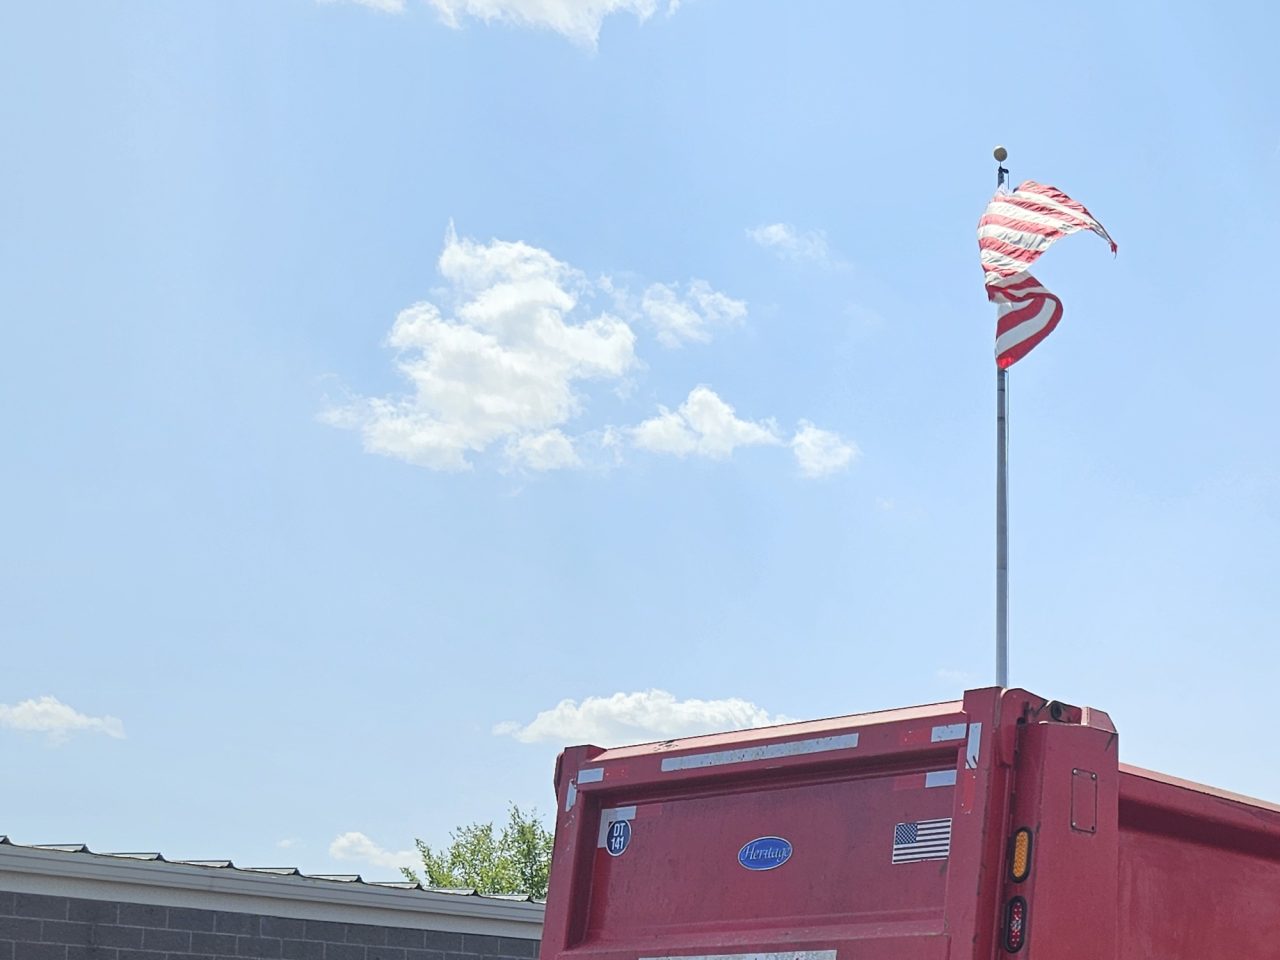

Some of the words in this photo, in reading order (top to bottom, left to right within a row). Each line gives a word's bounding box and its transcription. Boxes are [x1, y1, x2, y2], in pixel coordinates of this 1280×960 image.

[613, 822, 626, 837] DT
[611, 836, 625, 850] 141
[741, 842, 790, 863] Heritage
